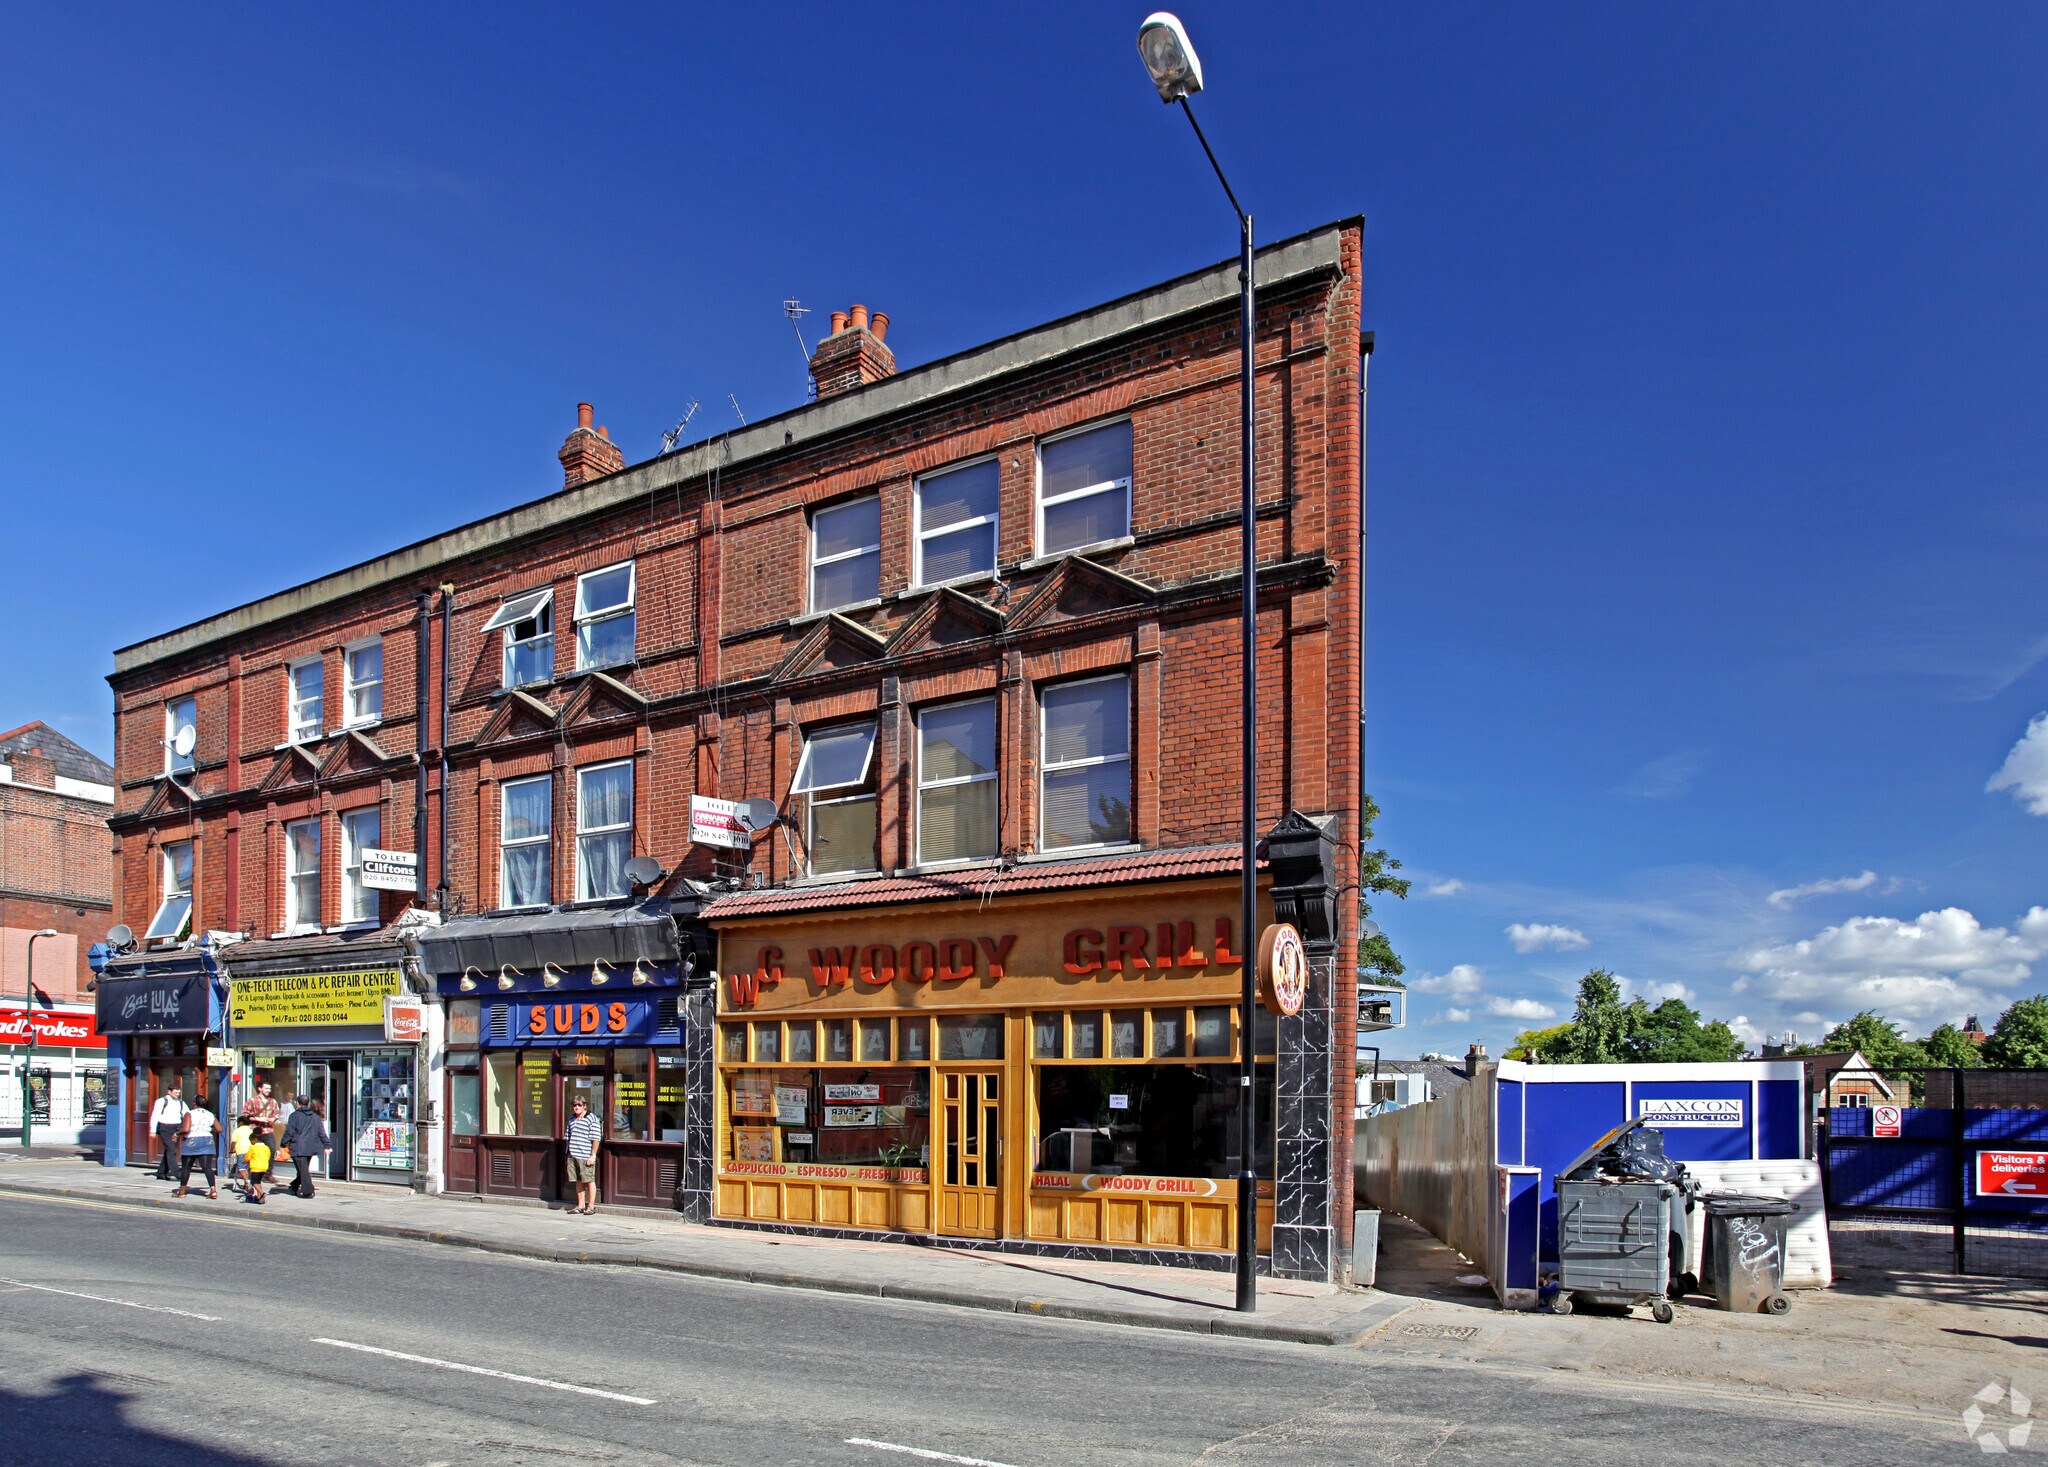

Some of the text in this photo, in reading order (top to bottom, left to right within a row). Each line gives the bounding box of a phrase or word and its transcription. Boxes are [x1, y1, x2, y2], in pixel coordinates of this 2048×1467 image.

[365, 862, 416, 875] Cliftons
[807, 918, 1242, 987] WOODY GRILL
[237, 972, 395, 994] ONE-TECH TELECOM & PC REPAIR CENTRE
[121, 993, 149, 1019] Bar
[272, 1013, 348, 1023] Tel/Fax: 020 8830 0144
[530, 1002, 627, 1033] SUDS
[760, 1028, 922, 1054] HALAL
[1037, 1021, 1177, 1049] MEAT
[1645, 1101, 1739, 1112] LAXCON
[1990, 1155, 2046, 1164] Visitors &
[1991, 1164, 2046, 1173] deliveries
[726, 1162, 787, 1176] CAPPUCCINO
[797, 1165, 848, 1180] ESPRESSO
[859, 1168, 893, 1181] FRESH
[895, 1169, 928, 1183] JUICE
[1035, 1175, 1197, 1193] HALAL WOODY GRILL
